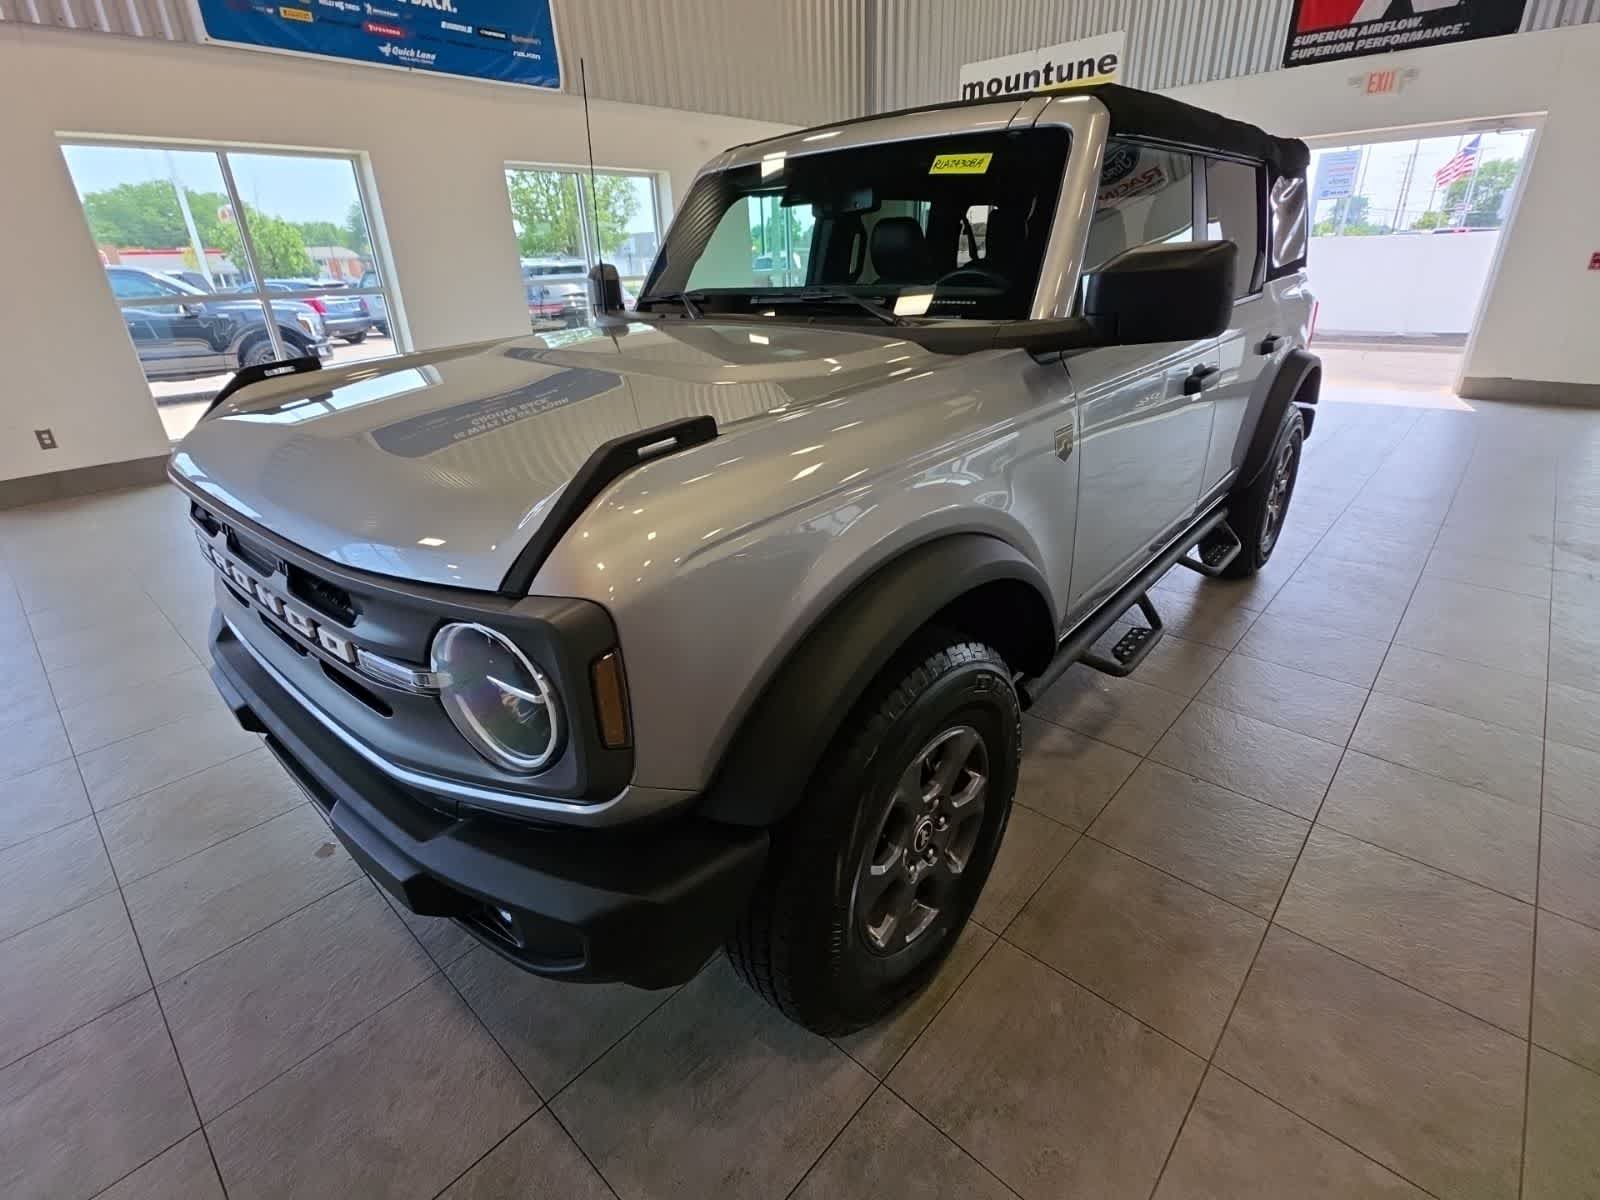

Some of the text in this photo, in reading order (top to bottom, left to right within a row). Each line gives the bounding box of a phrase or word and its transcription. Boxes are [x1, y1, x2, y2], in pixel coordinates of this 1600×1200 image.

[1292, 16, 1423, 47] SUPERIOR AIRFLOW.
[392, 46, 437, 60] Quick Lane
[1289, 41, 1355, 60] SUPERIOR
[962, 53, 1118, 100] mountune
[1366, 71, 1396, 93] EXIT
